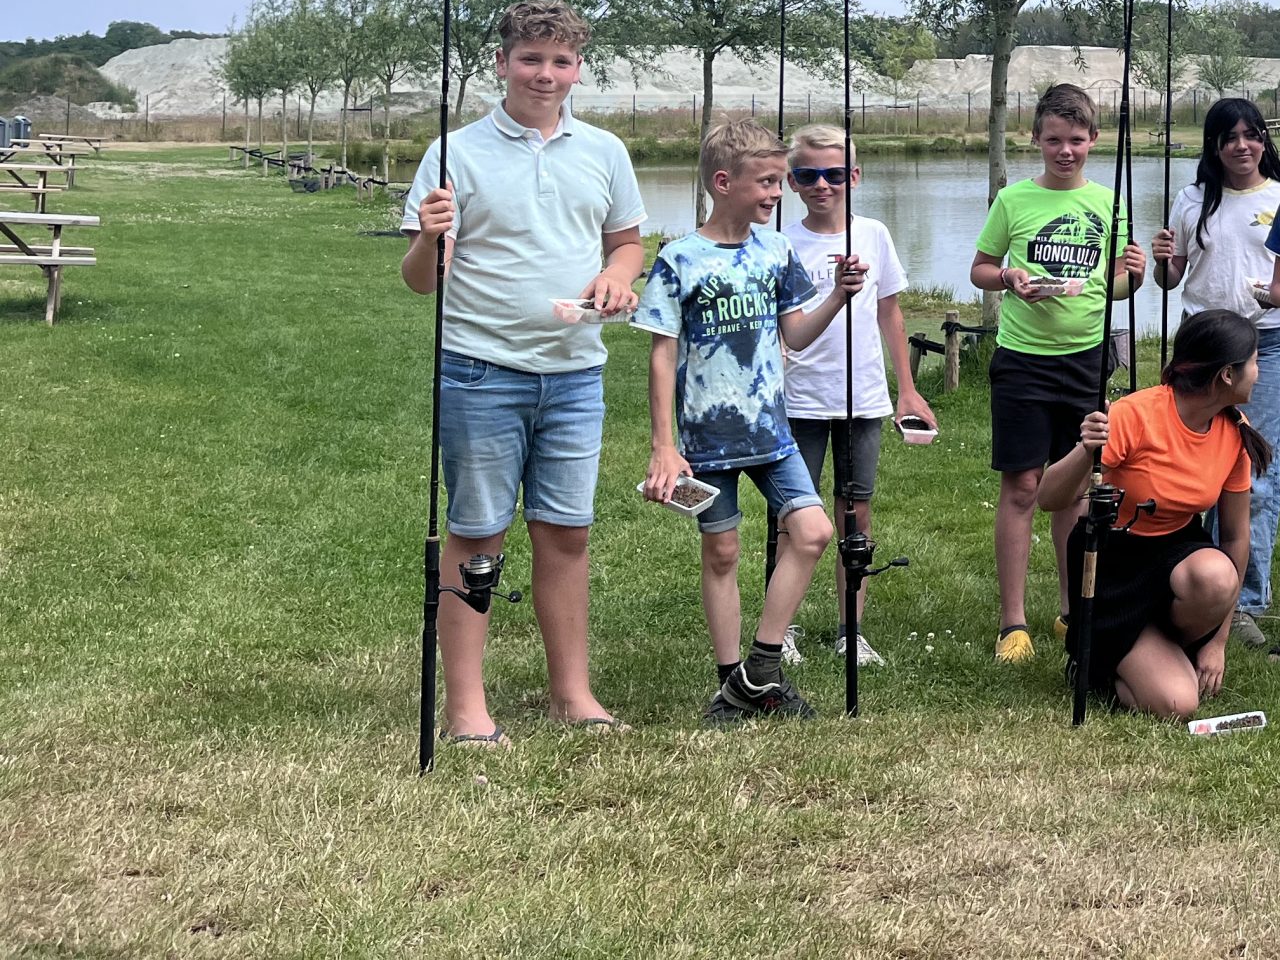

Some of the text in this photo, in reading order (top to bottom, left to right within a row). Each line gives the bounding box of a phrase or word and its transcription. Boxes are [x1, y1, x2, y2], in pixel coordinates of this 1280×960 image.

[1034, 243, 1098, 267] HONOLULU
[702, 310, 714, 324] 19
[717, 291, 769, 322] ROCKS
[706, 327, 716, 336] BE
[718, 323, 741, 335] BRAVE
